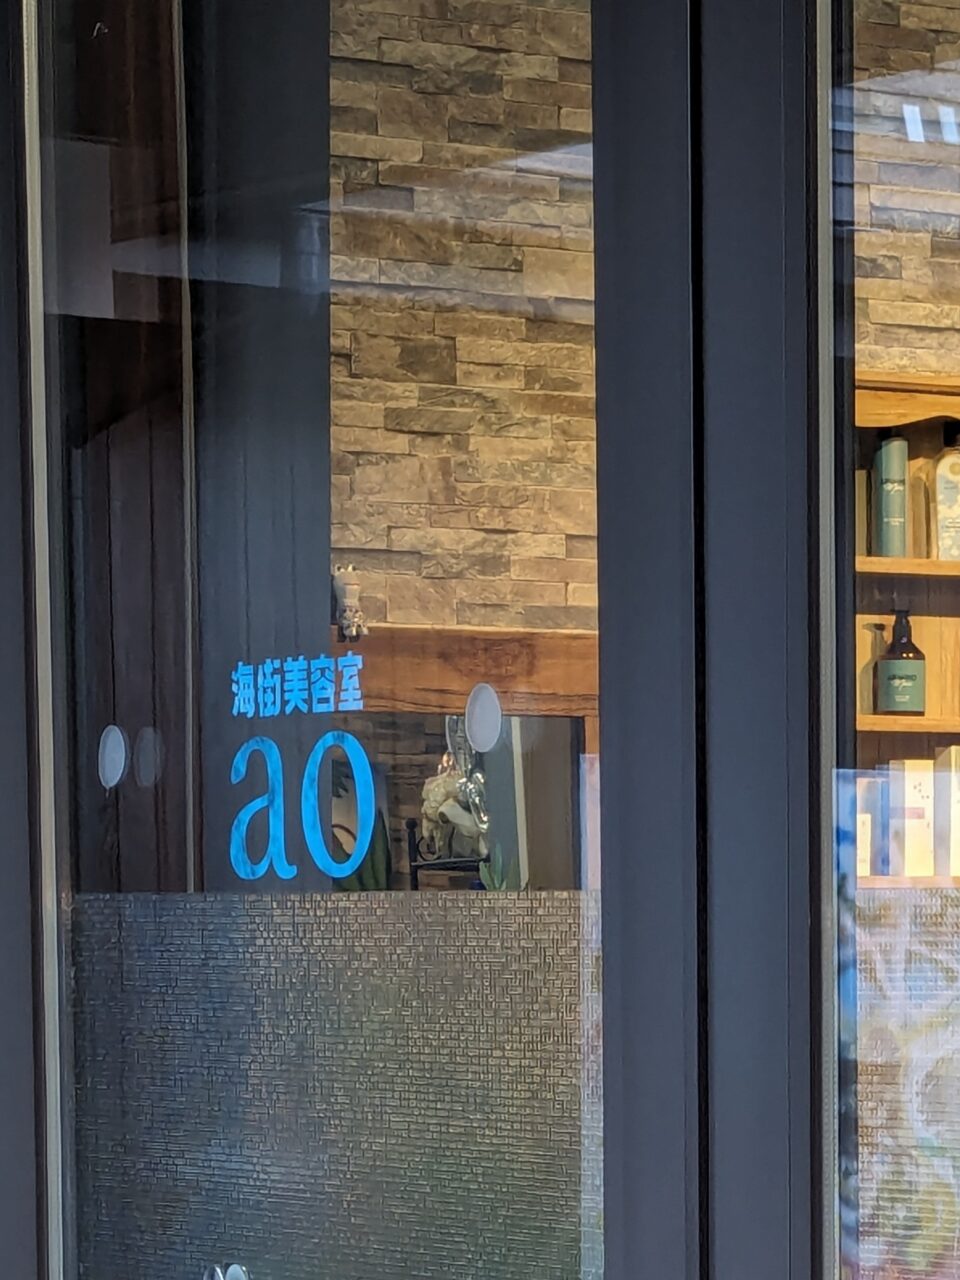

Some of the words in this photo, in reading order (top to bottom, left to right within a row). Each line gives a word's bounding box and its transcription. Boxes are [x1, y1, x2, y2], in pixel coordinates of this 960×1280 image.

[231, 650, 364, 719] 海街美容室
[230, 730, 375, 880] ao
